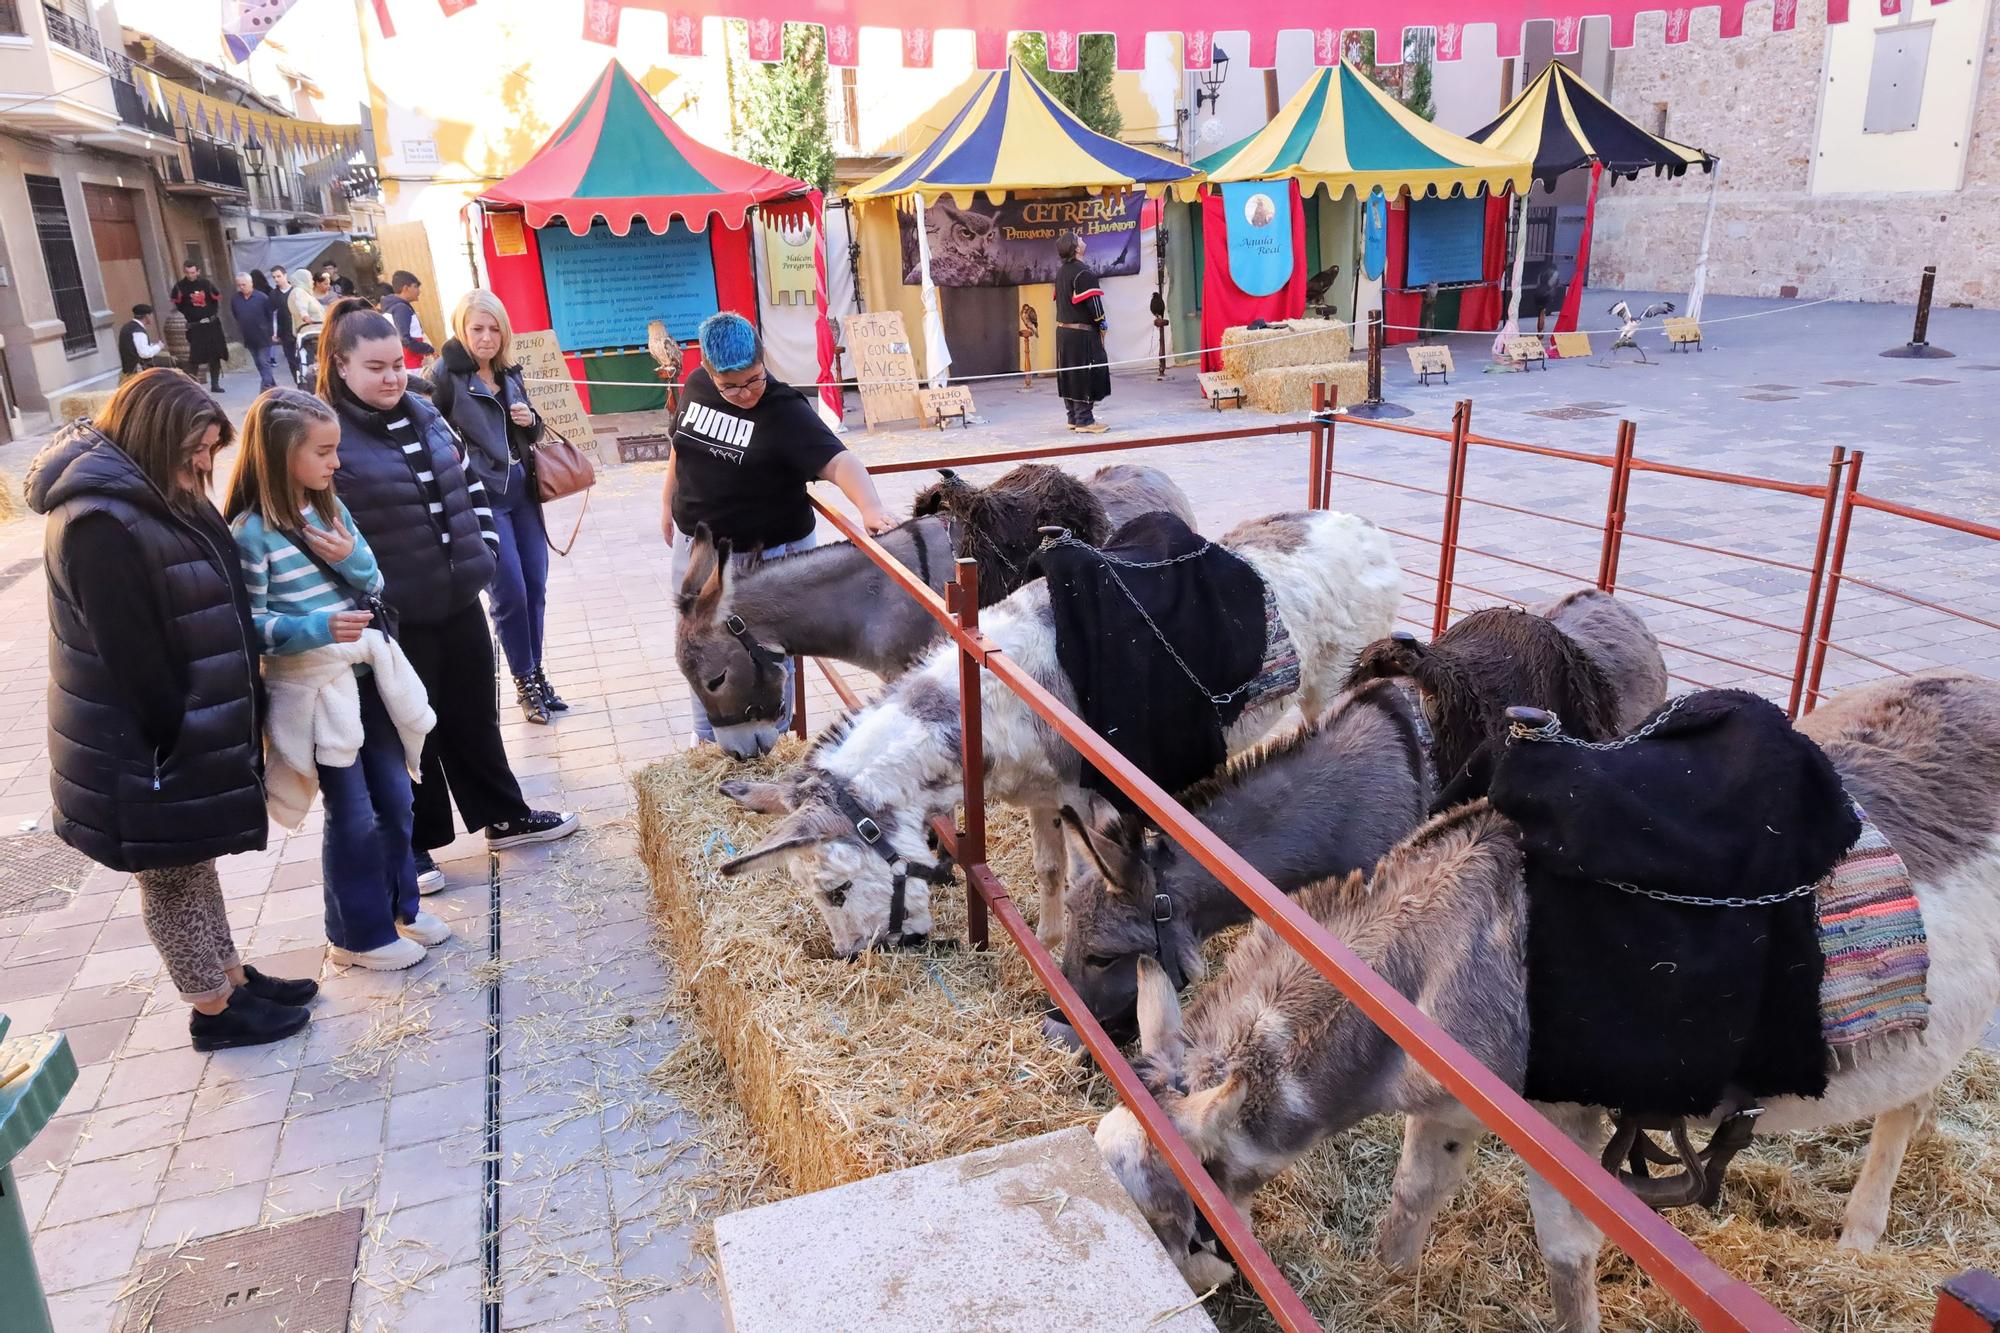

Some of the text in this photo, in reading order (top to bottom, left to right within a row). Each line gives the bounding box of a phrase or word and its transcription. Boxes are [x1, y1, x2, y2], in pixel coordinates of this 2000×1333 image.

[1087, 220, 1137, 236] HUMANIDAD
[868, 344, 890, 356] CON
[543, 352, 556, 363] LA
[863, 361, 907, 377] AVES
[542, 399, 567, 411] UNA
[543, 412, 579, 426] ONEDA
[681, 401, 755, 448] PUMA
[576, 439, 598, 452] ESEO
